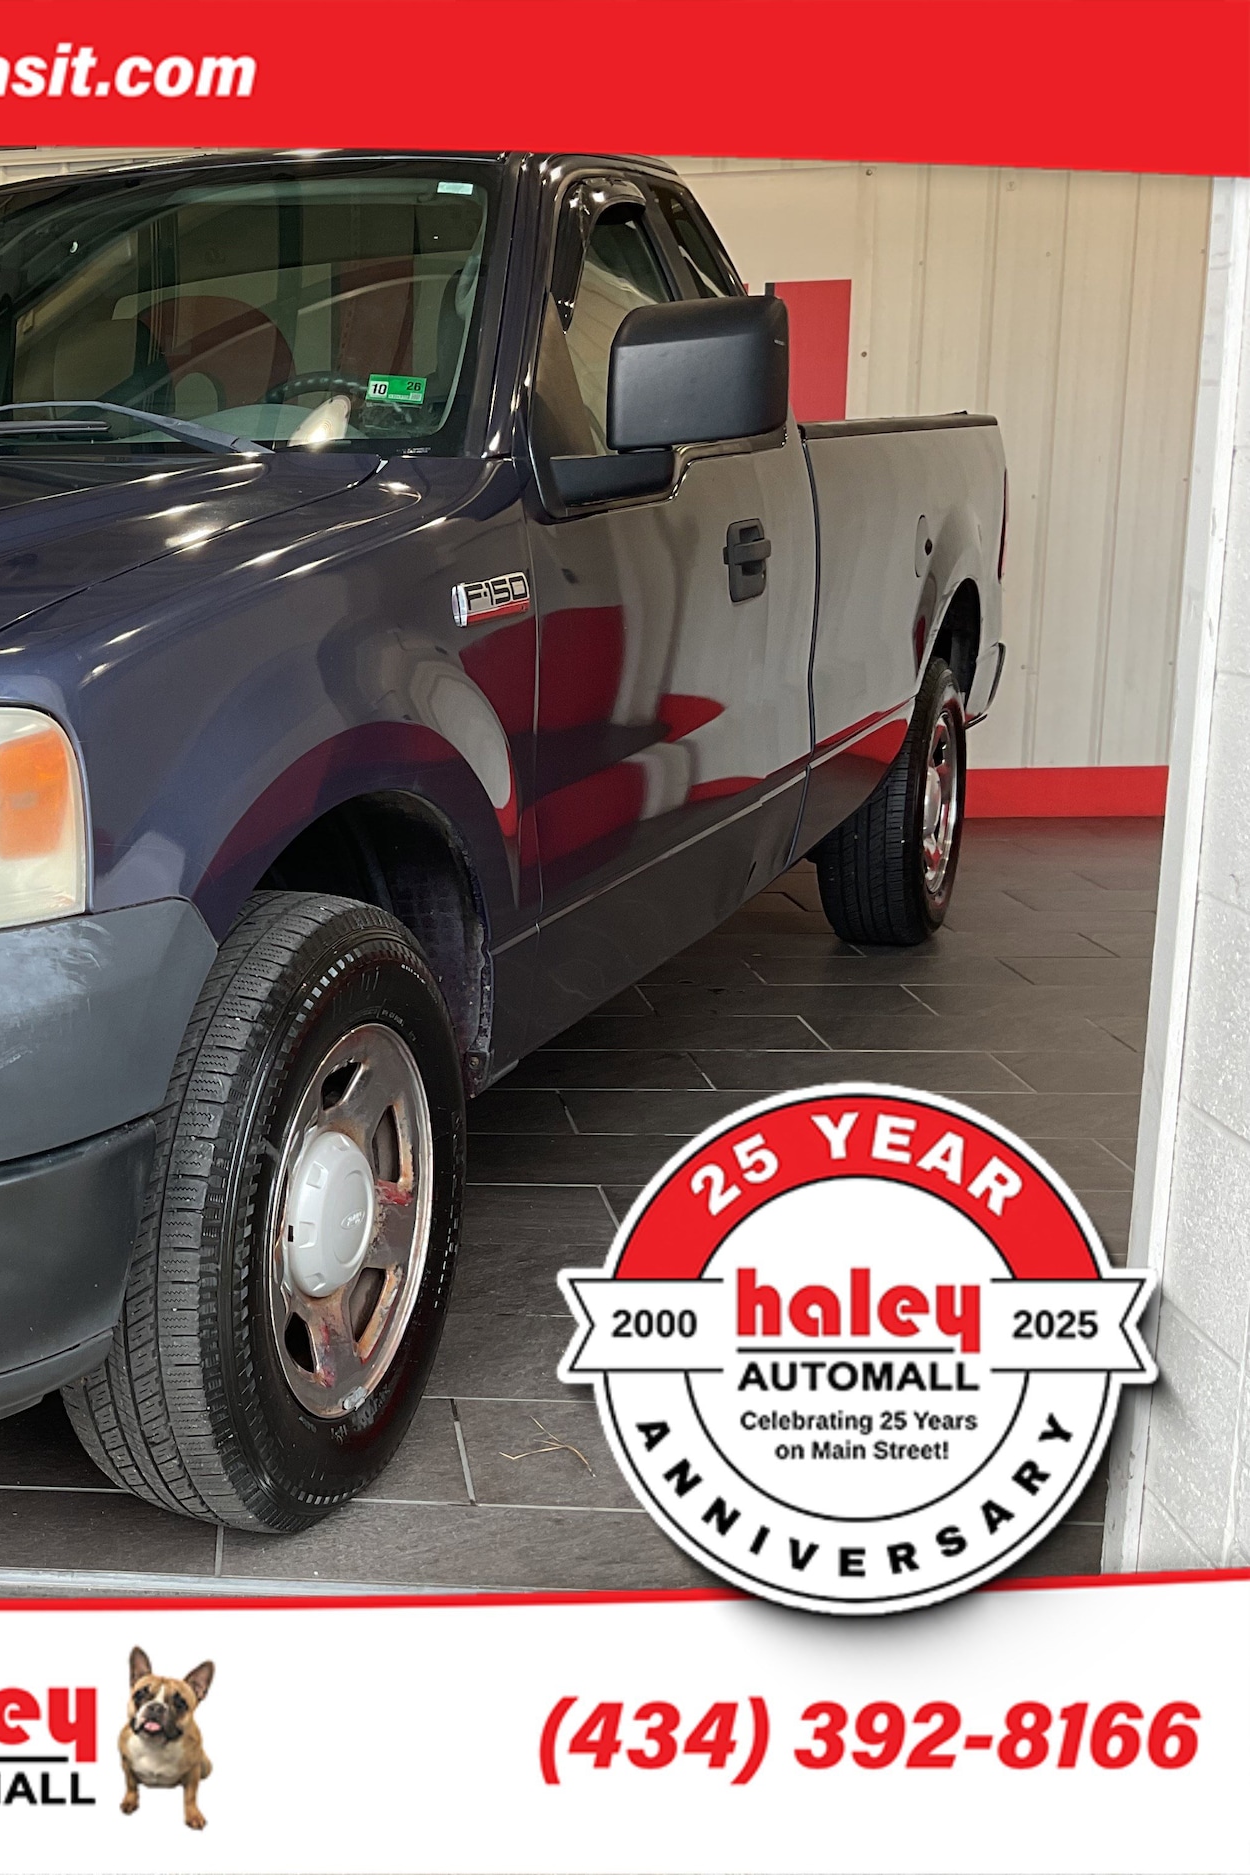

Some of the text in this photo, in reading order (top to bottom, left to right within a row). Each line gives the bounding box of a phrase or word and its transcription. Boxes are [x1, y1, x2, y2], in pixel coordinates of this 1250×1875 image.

[371, 381, 421, 395] 10 26
[463, 576, 528, 611] F-150
